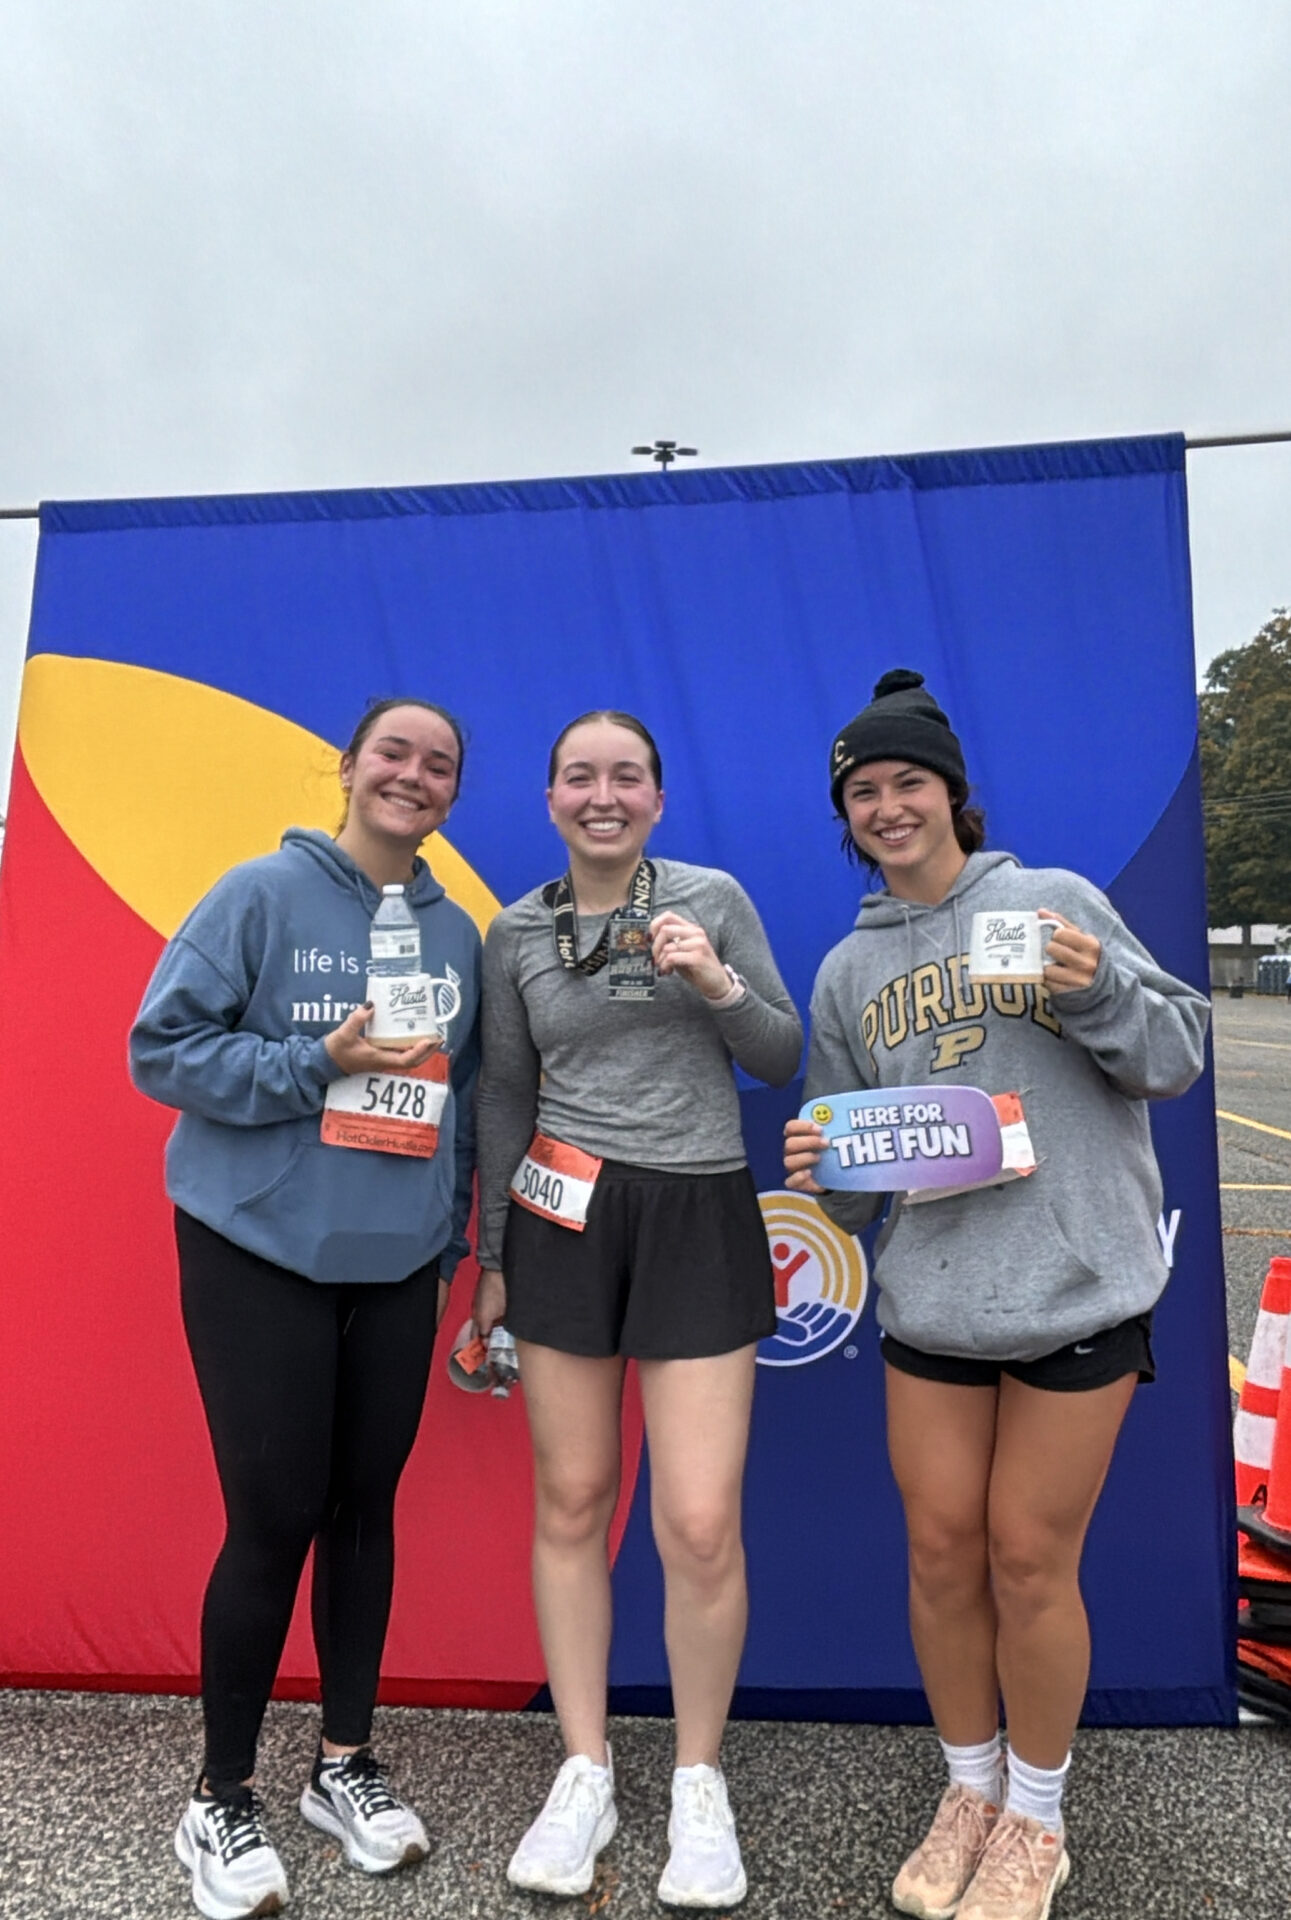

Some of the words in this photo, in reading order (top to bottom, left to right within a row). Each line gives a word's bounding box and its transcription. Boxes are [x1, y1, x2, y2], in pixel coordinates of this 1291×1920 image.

[984, 921, 1026, 943] Hustle
[294, 947, 333, 974] life
[339, 950, 359, 974] is
[930, 1025, 986, 1074] P
[361, 1077, 426, 1118] 5428
[849, 1105, 901, 1129] HERE
[903, 1102, 944, 1125] FOR
[831, 1130, 897, 1168] THE
[899, 1123, 971, 1160] FUN
[520, 1163, 564, 1211] 5040
